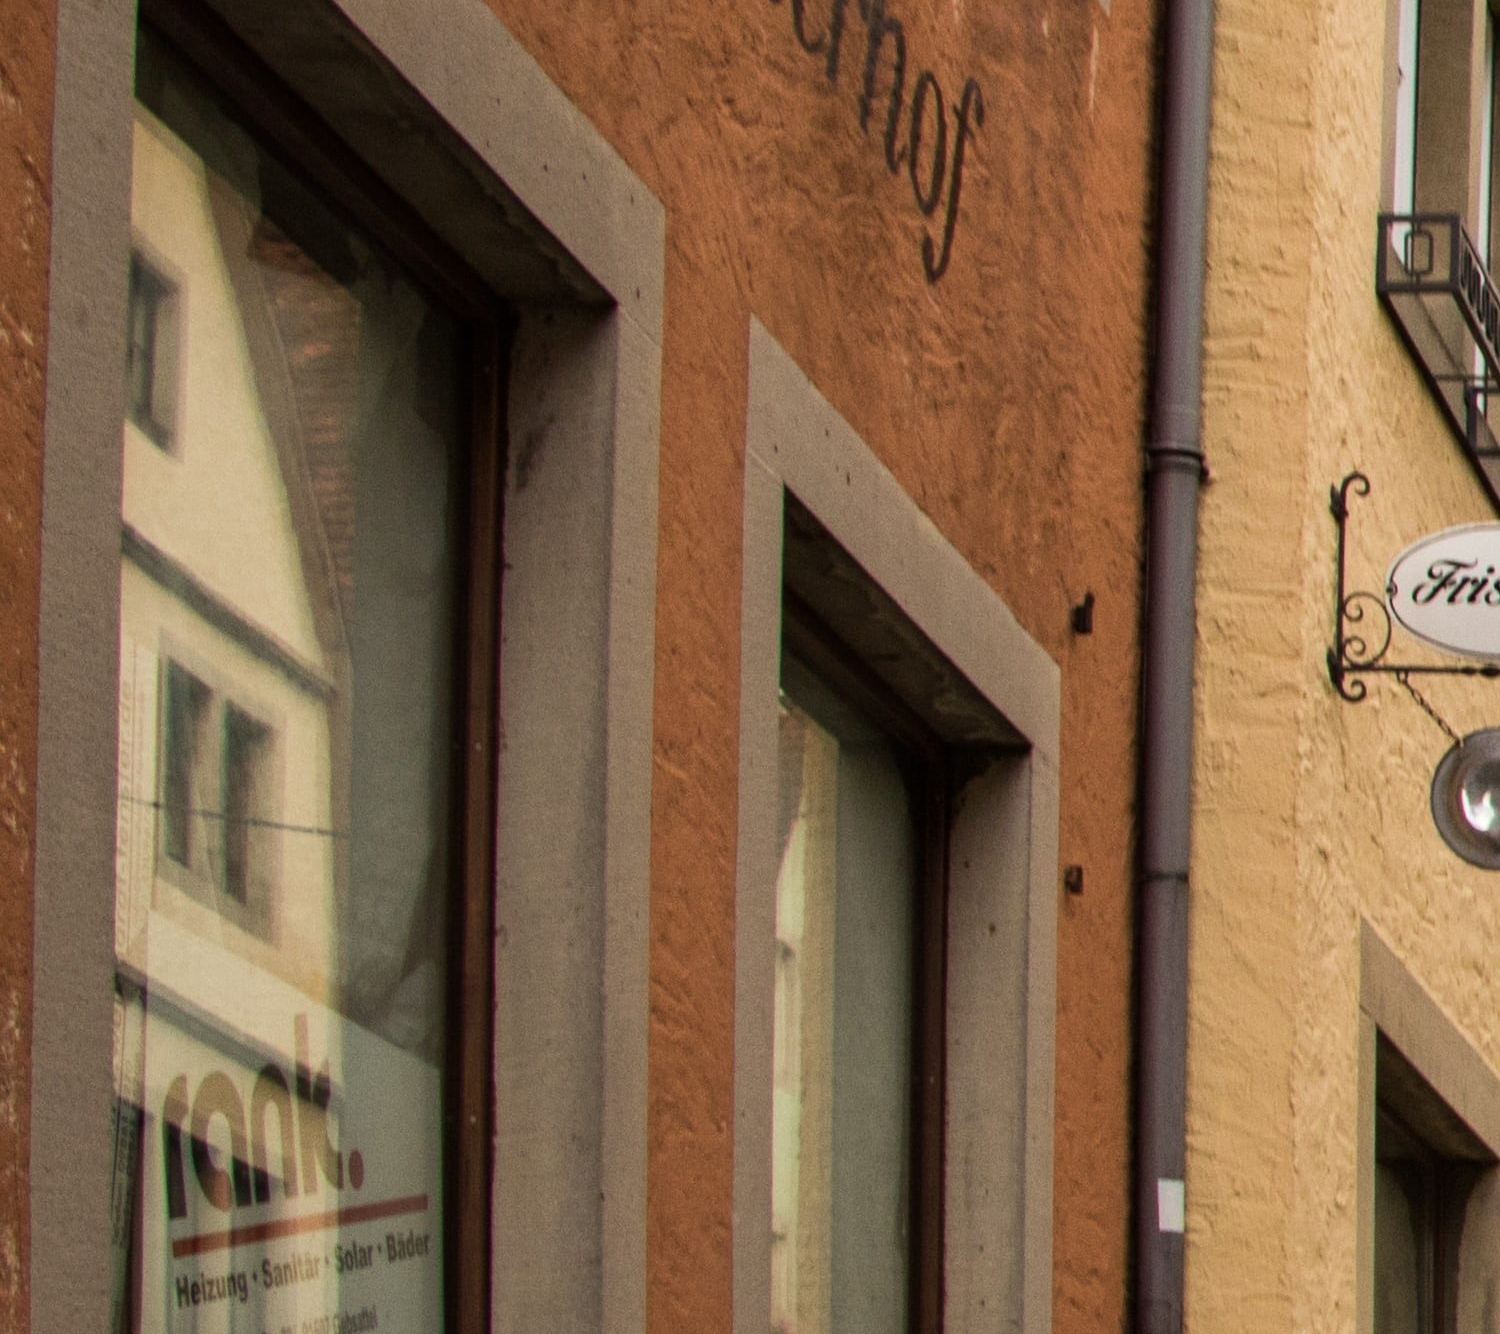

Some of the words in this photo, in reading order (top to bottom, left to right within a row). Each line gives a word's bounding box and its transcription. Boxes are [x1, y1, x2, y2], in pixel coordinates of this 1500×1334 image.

[176, 1271, 249, 1308] Heizung
[262, 1252, 320, 1289] Sanitär
[335, 1240, 373, 1274] Solar
[386, 1232, 430, 1264] Bäder
